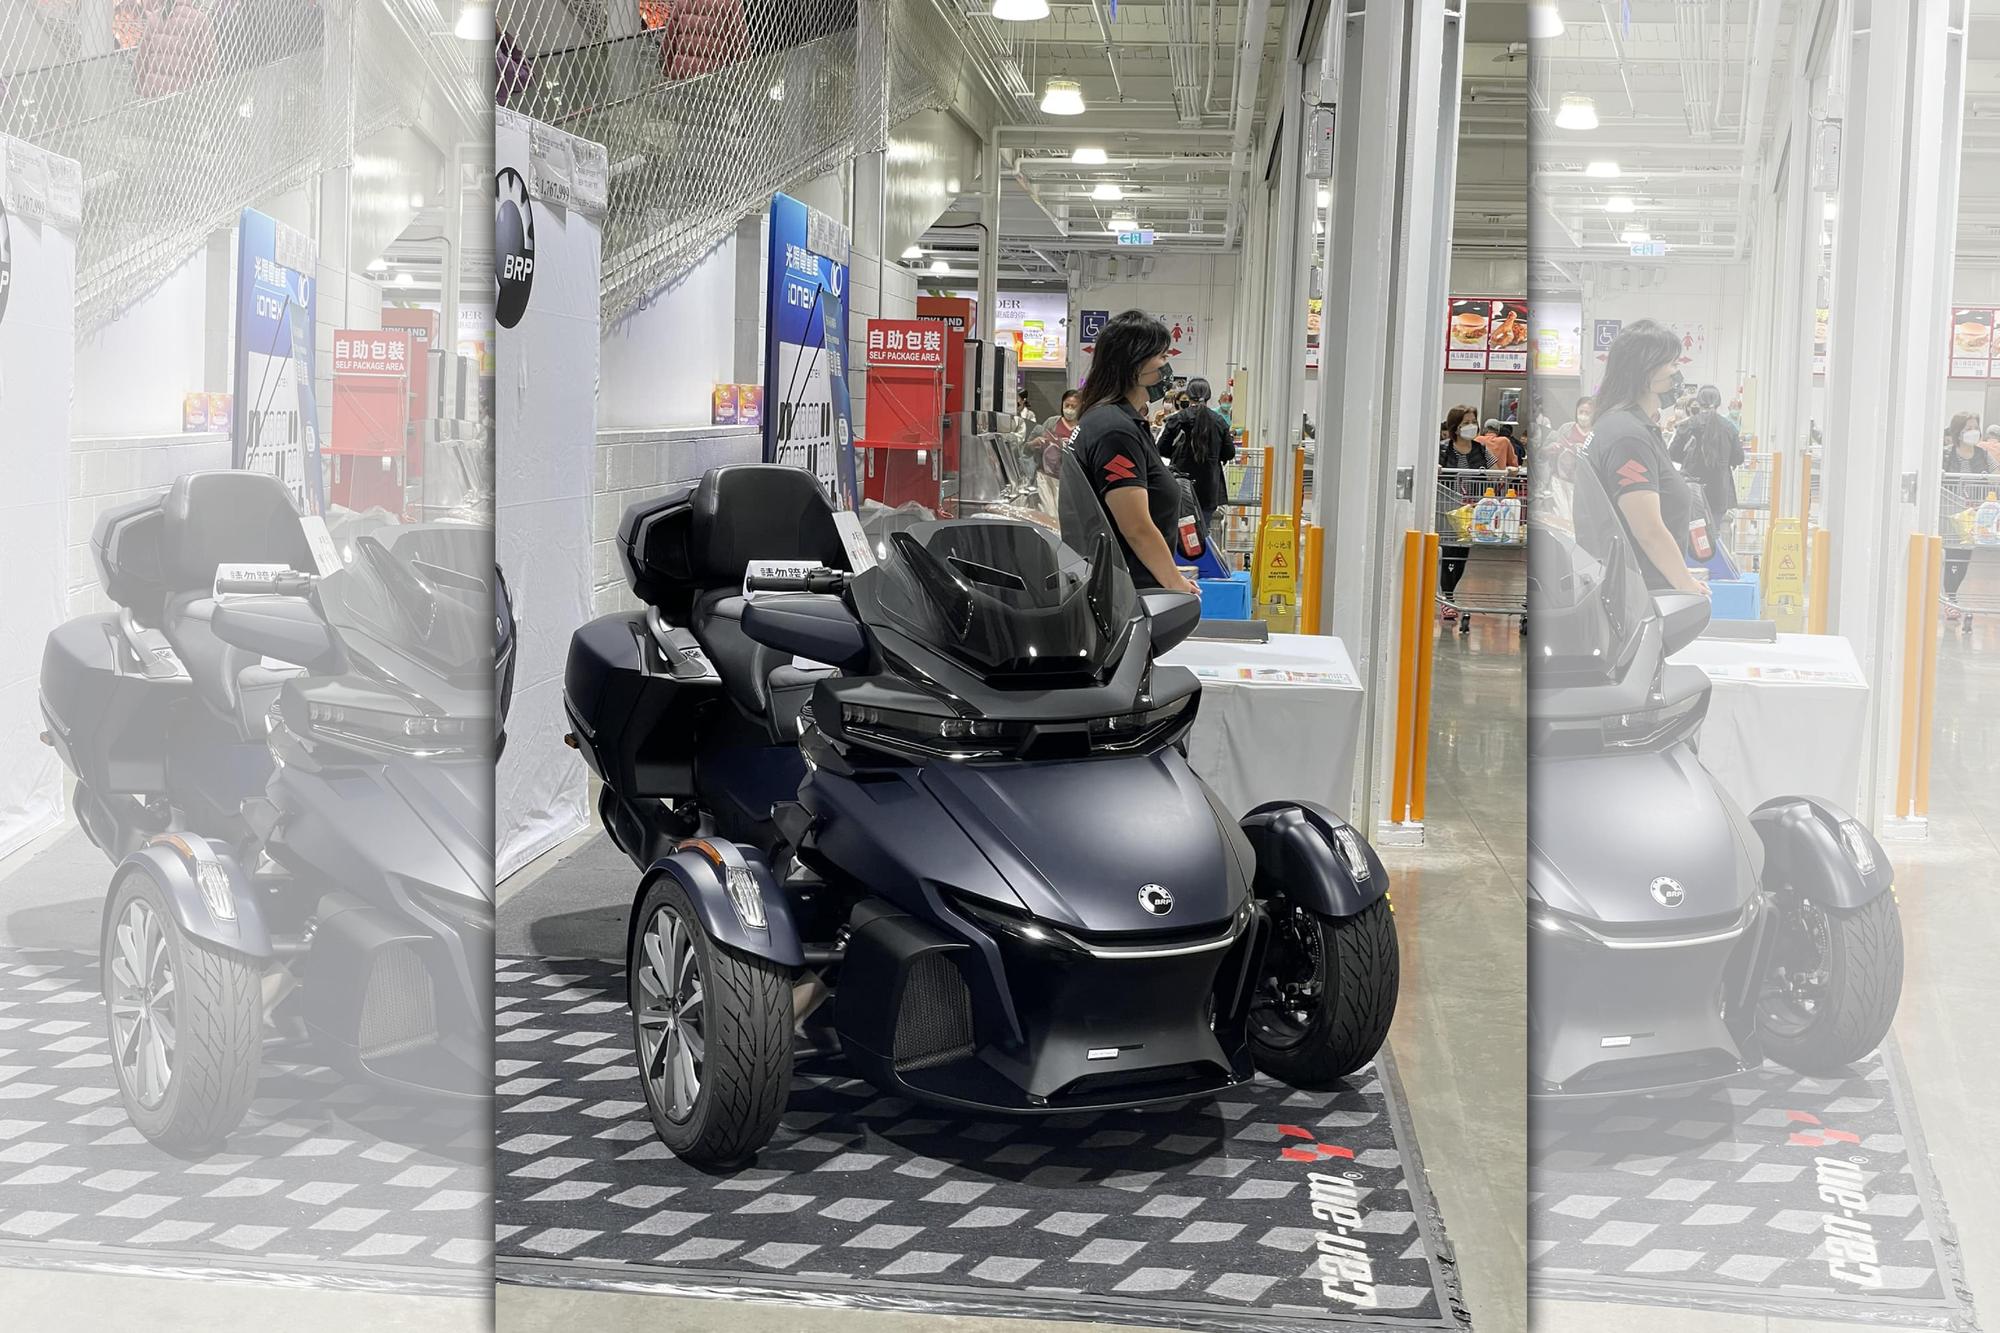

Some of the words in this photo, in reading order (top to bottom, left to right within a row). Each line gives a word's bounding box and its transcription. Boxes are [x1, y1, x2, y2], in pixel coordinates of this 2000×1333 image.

[503, 253, 533, 282] BRP
[869, 329, 941, 351] 自助包裝
[335, 339, 405, 361] 自助包裝
[869, 351, 886, 360] SELF
[887, 352, 920, 361] PACKAGE
[921, 353, 940, 362] AREA
[335, 360, 353, 369] SELF
[353, 361, 385, 370] PACKAGE
[385, 362, 405, 371] AREA
[1154, 898, 1172, 906] BRP
